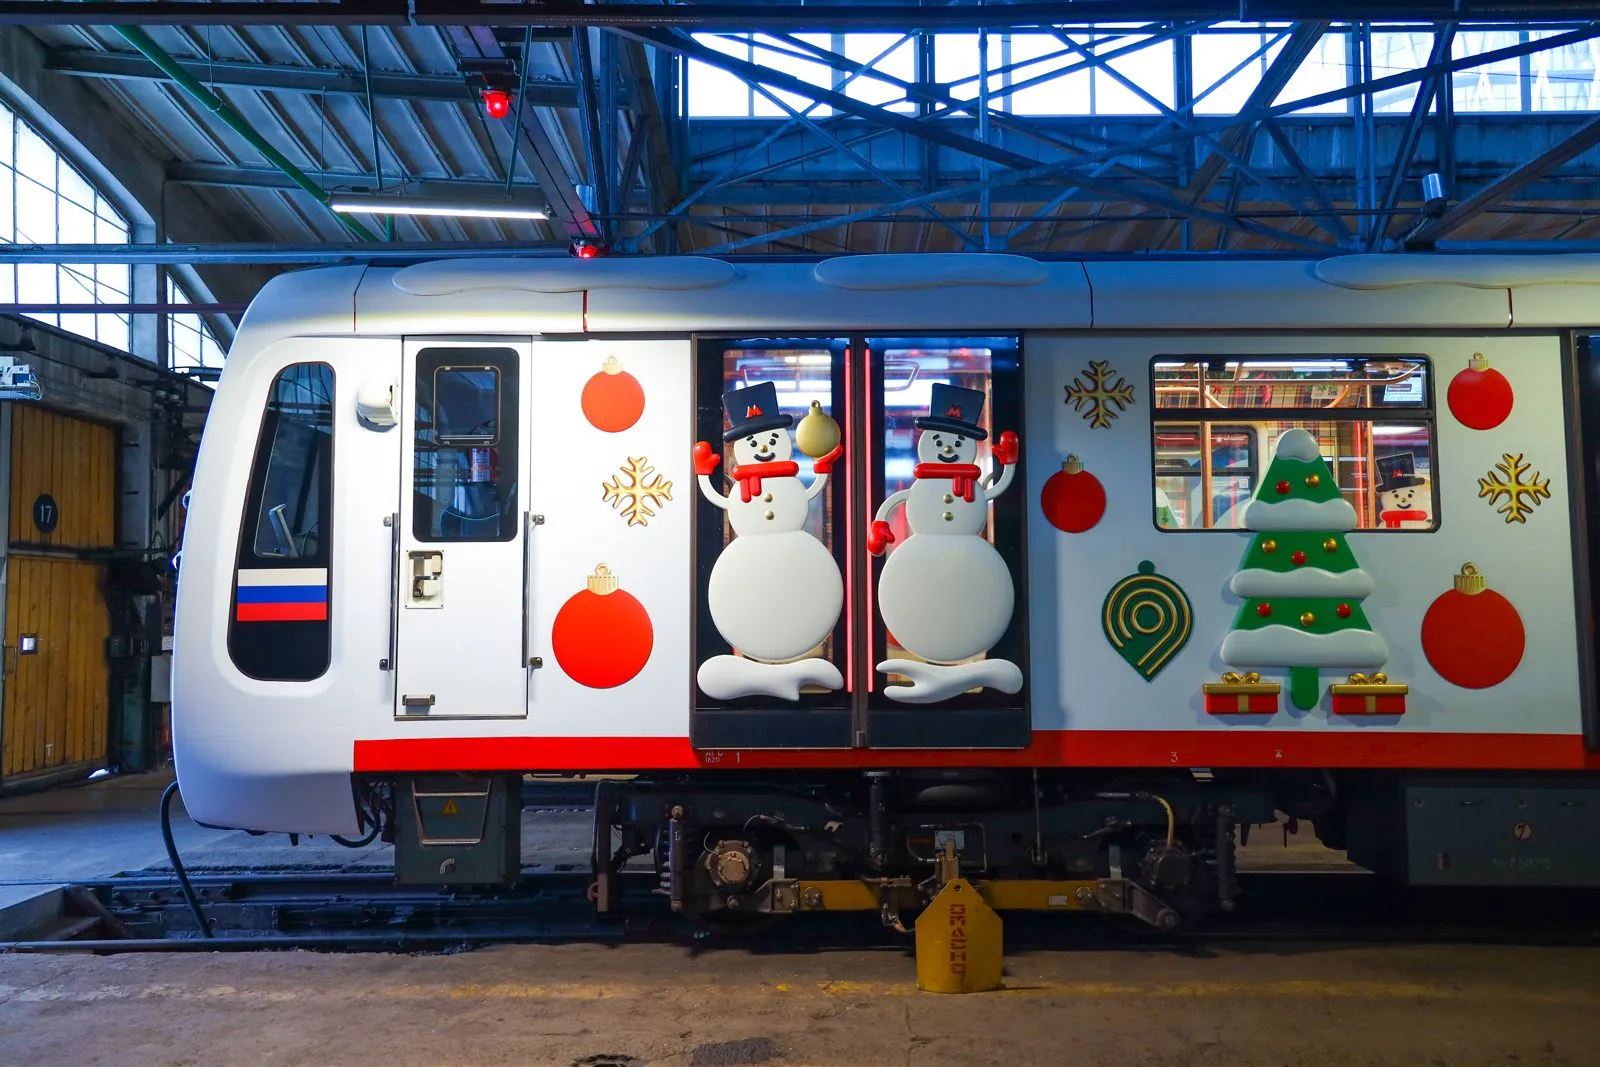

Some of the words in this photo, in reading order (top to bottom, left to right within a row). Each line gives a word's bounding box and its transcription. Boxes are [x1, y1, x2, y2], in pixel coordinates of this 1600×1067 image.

[41, 504, 52, 523] 17
[736, 751, 740, 763] 1
[1170, 751, 1178, 763] 3
